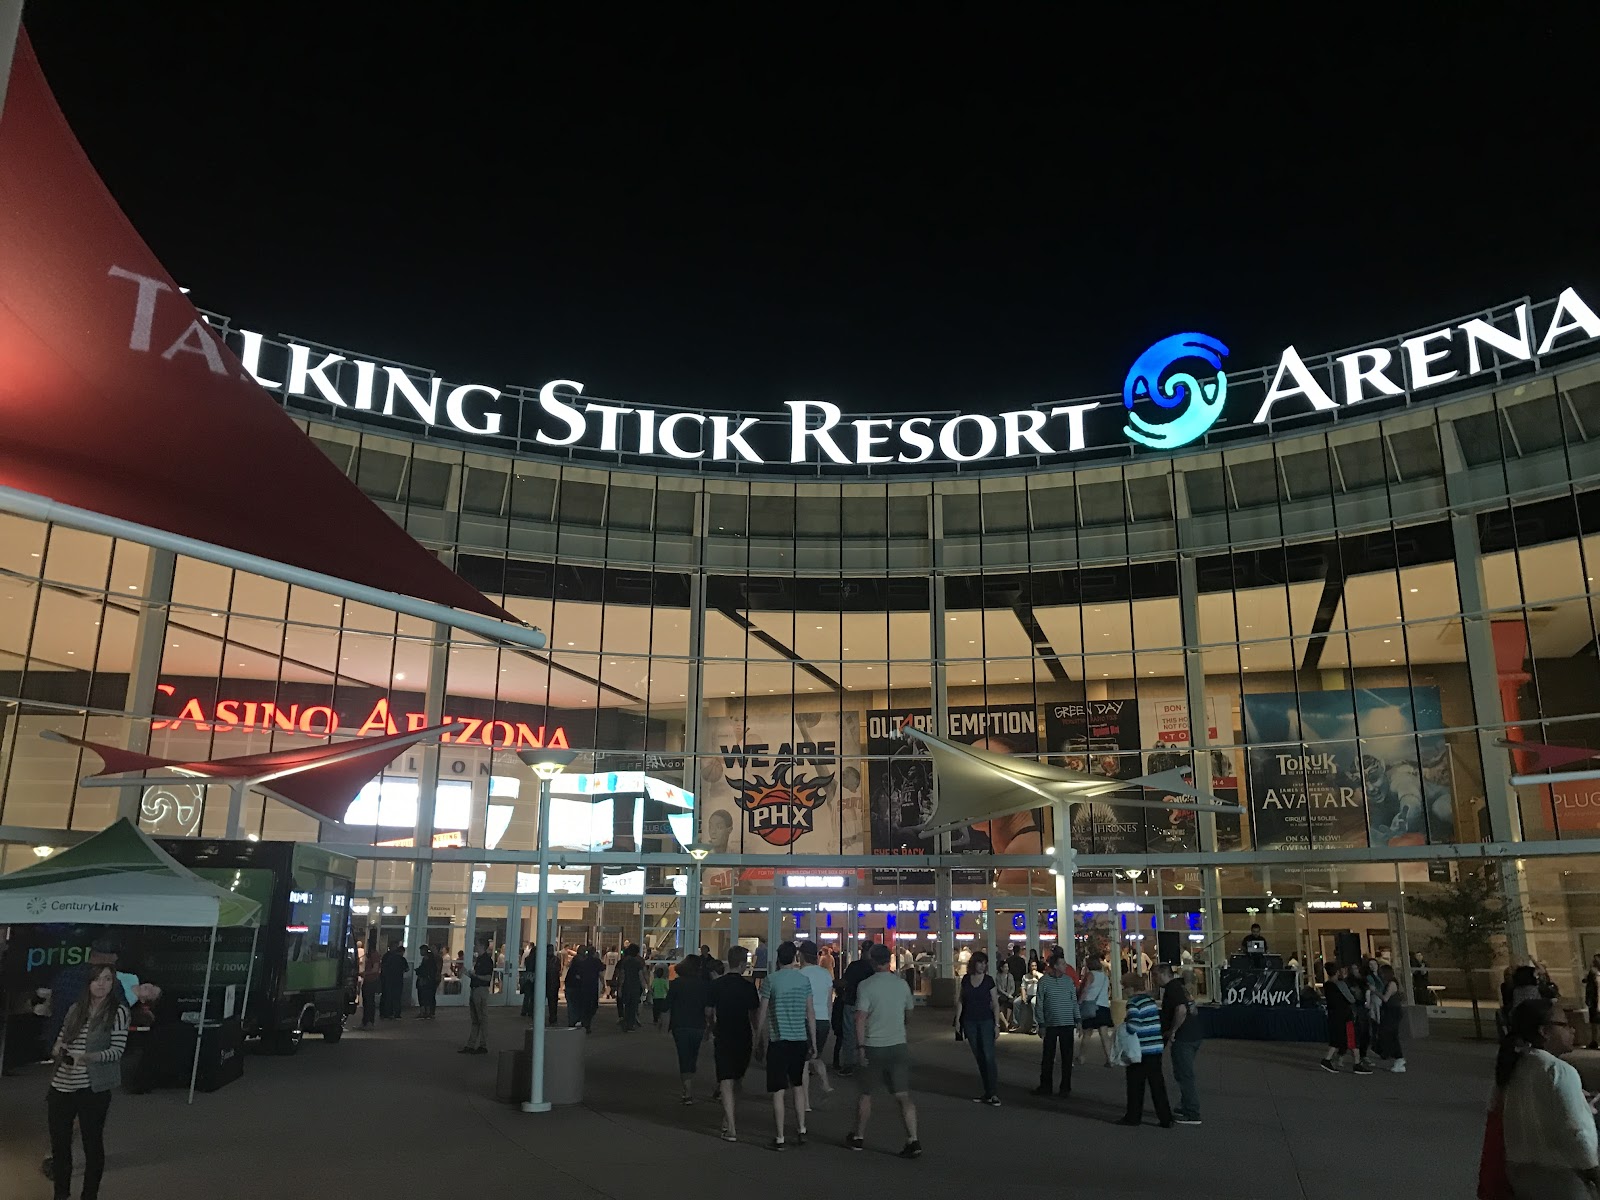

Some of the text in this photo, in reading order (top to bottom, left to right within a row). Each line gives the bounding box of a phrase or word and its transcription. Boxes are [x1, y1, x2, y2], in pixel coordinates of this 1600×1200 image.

[108, 264, 1600, 464] TALKING STICK RESORT ARENA
[1053, 701, 1124, 718] GREEN DAY
[1164, 705, 1181, 713] BON
[1162, 717, 1177, 728] THIS
[1163, 724, 1176, 734] NOT
[720, 742, 836, 768] WE ARE
[1261, 786, 1359, 810] AVATAR
[752, 805, 809, 828] PHX
[1093, 822, 1138, 834] THRONES
[1318, 834, 1341, 842] NOW!
[51, 901, 119, 912] CenturyLink
[170, 934, 223, 943] CenturyLk
[27, 939, 92, 973] pris
[1228, 987, 1294, 1006] DJ HAVIK
